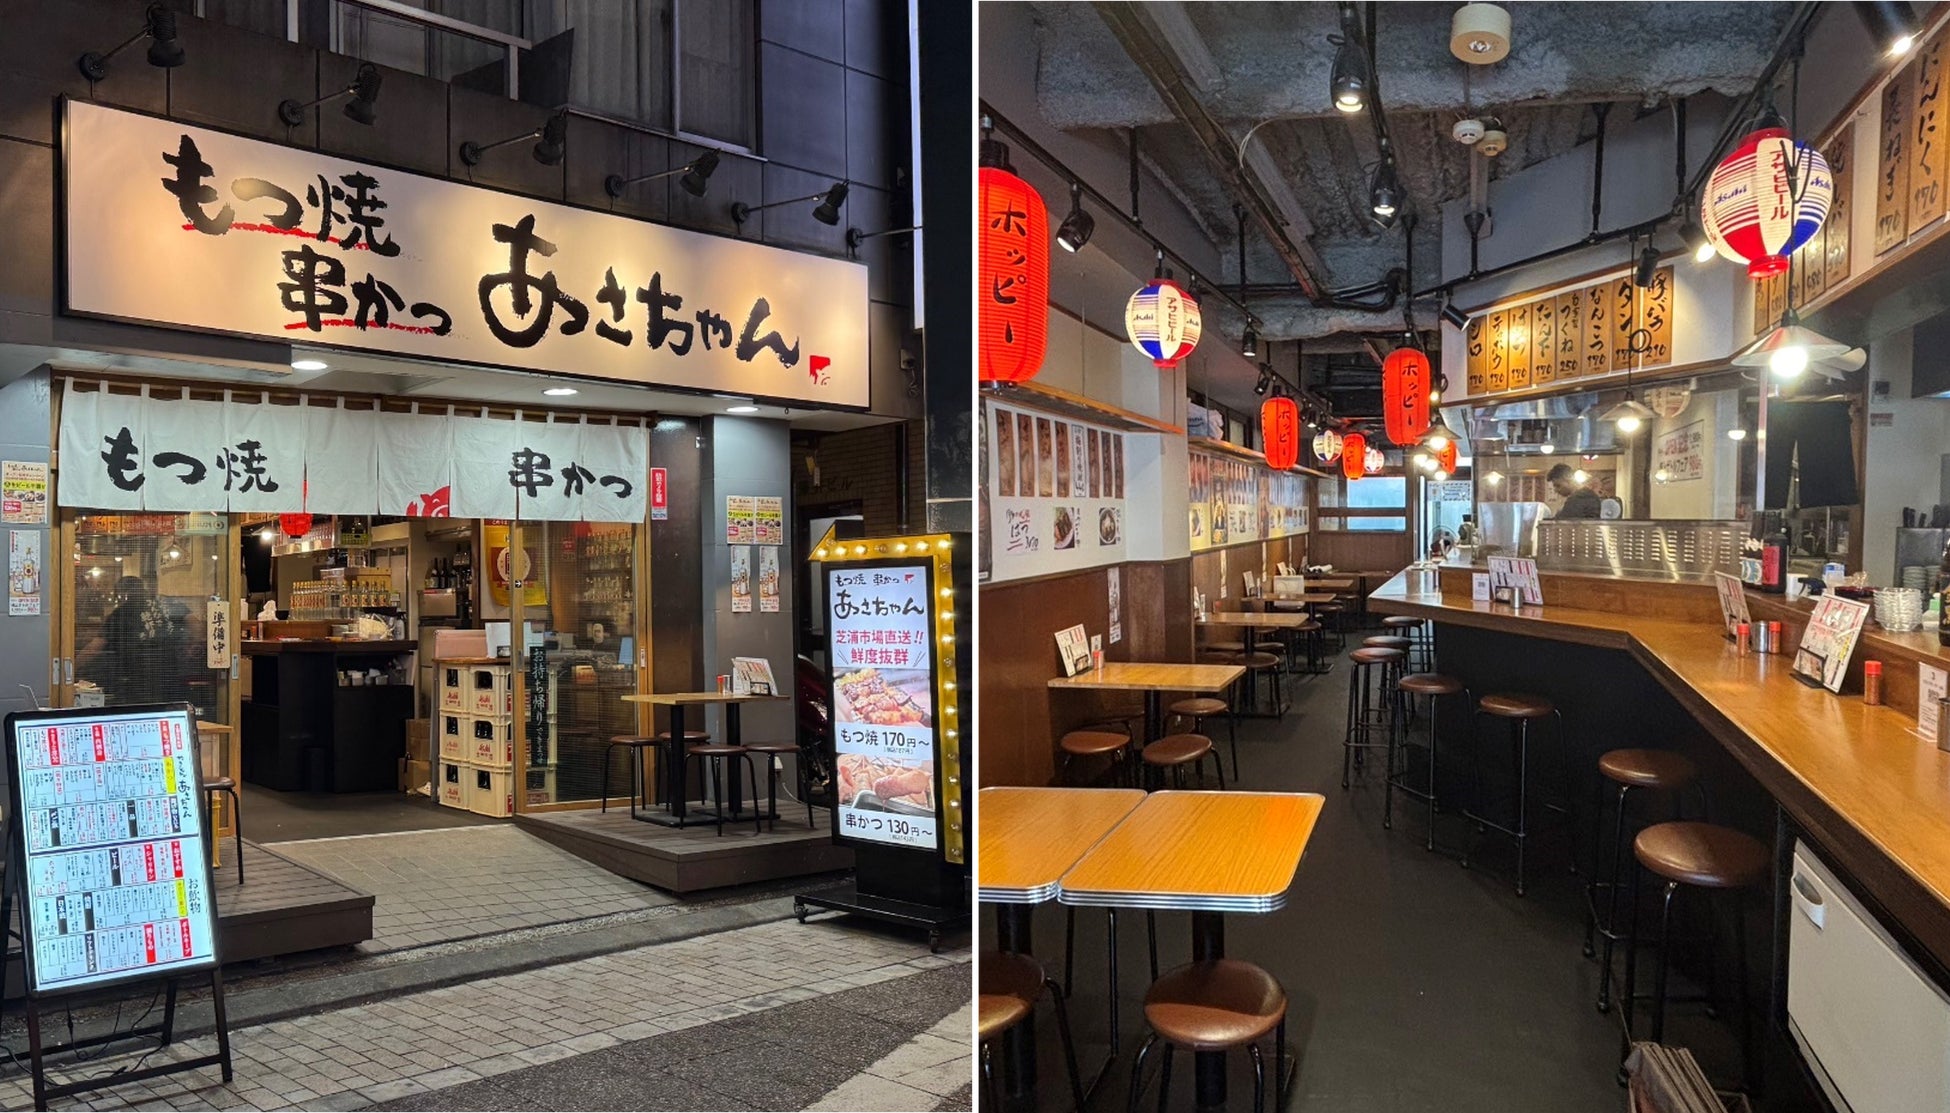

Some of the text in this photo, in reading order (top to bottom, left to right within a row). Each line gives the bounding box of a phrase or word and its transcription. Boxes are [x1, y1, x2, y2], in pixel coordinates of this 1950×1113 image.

[161, 134, 400, 257] もつ焼
[1714, 185, 1748, 206] Asahi
[277, 244, 452, 336] 串かつ
[991, 199, 1026, 343] ホッピー
[1469, 322, 1482, 357] シロ
[1589, 288, 1604, 351] なんこつ
[1560, 360, 1578, 371] 250
[1402, 361, 1418, 426] ホッピー
[1279, 410, 1291, 456] ホッピー
[101, 426, 279, 493] もつ焼
[508, 446, 633, 498] 串かつ
[835, 574, 900, 587] もつ焼 串かつ
[211, 611, 226, 655] 準備中
[851, 648, 909, 665] 鮮度抜群
[841, 728, 879, 746] もつ焼
[846, 812, 883, 830] 串かつ
